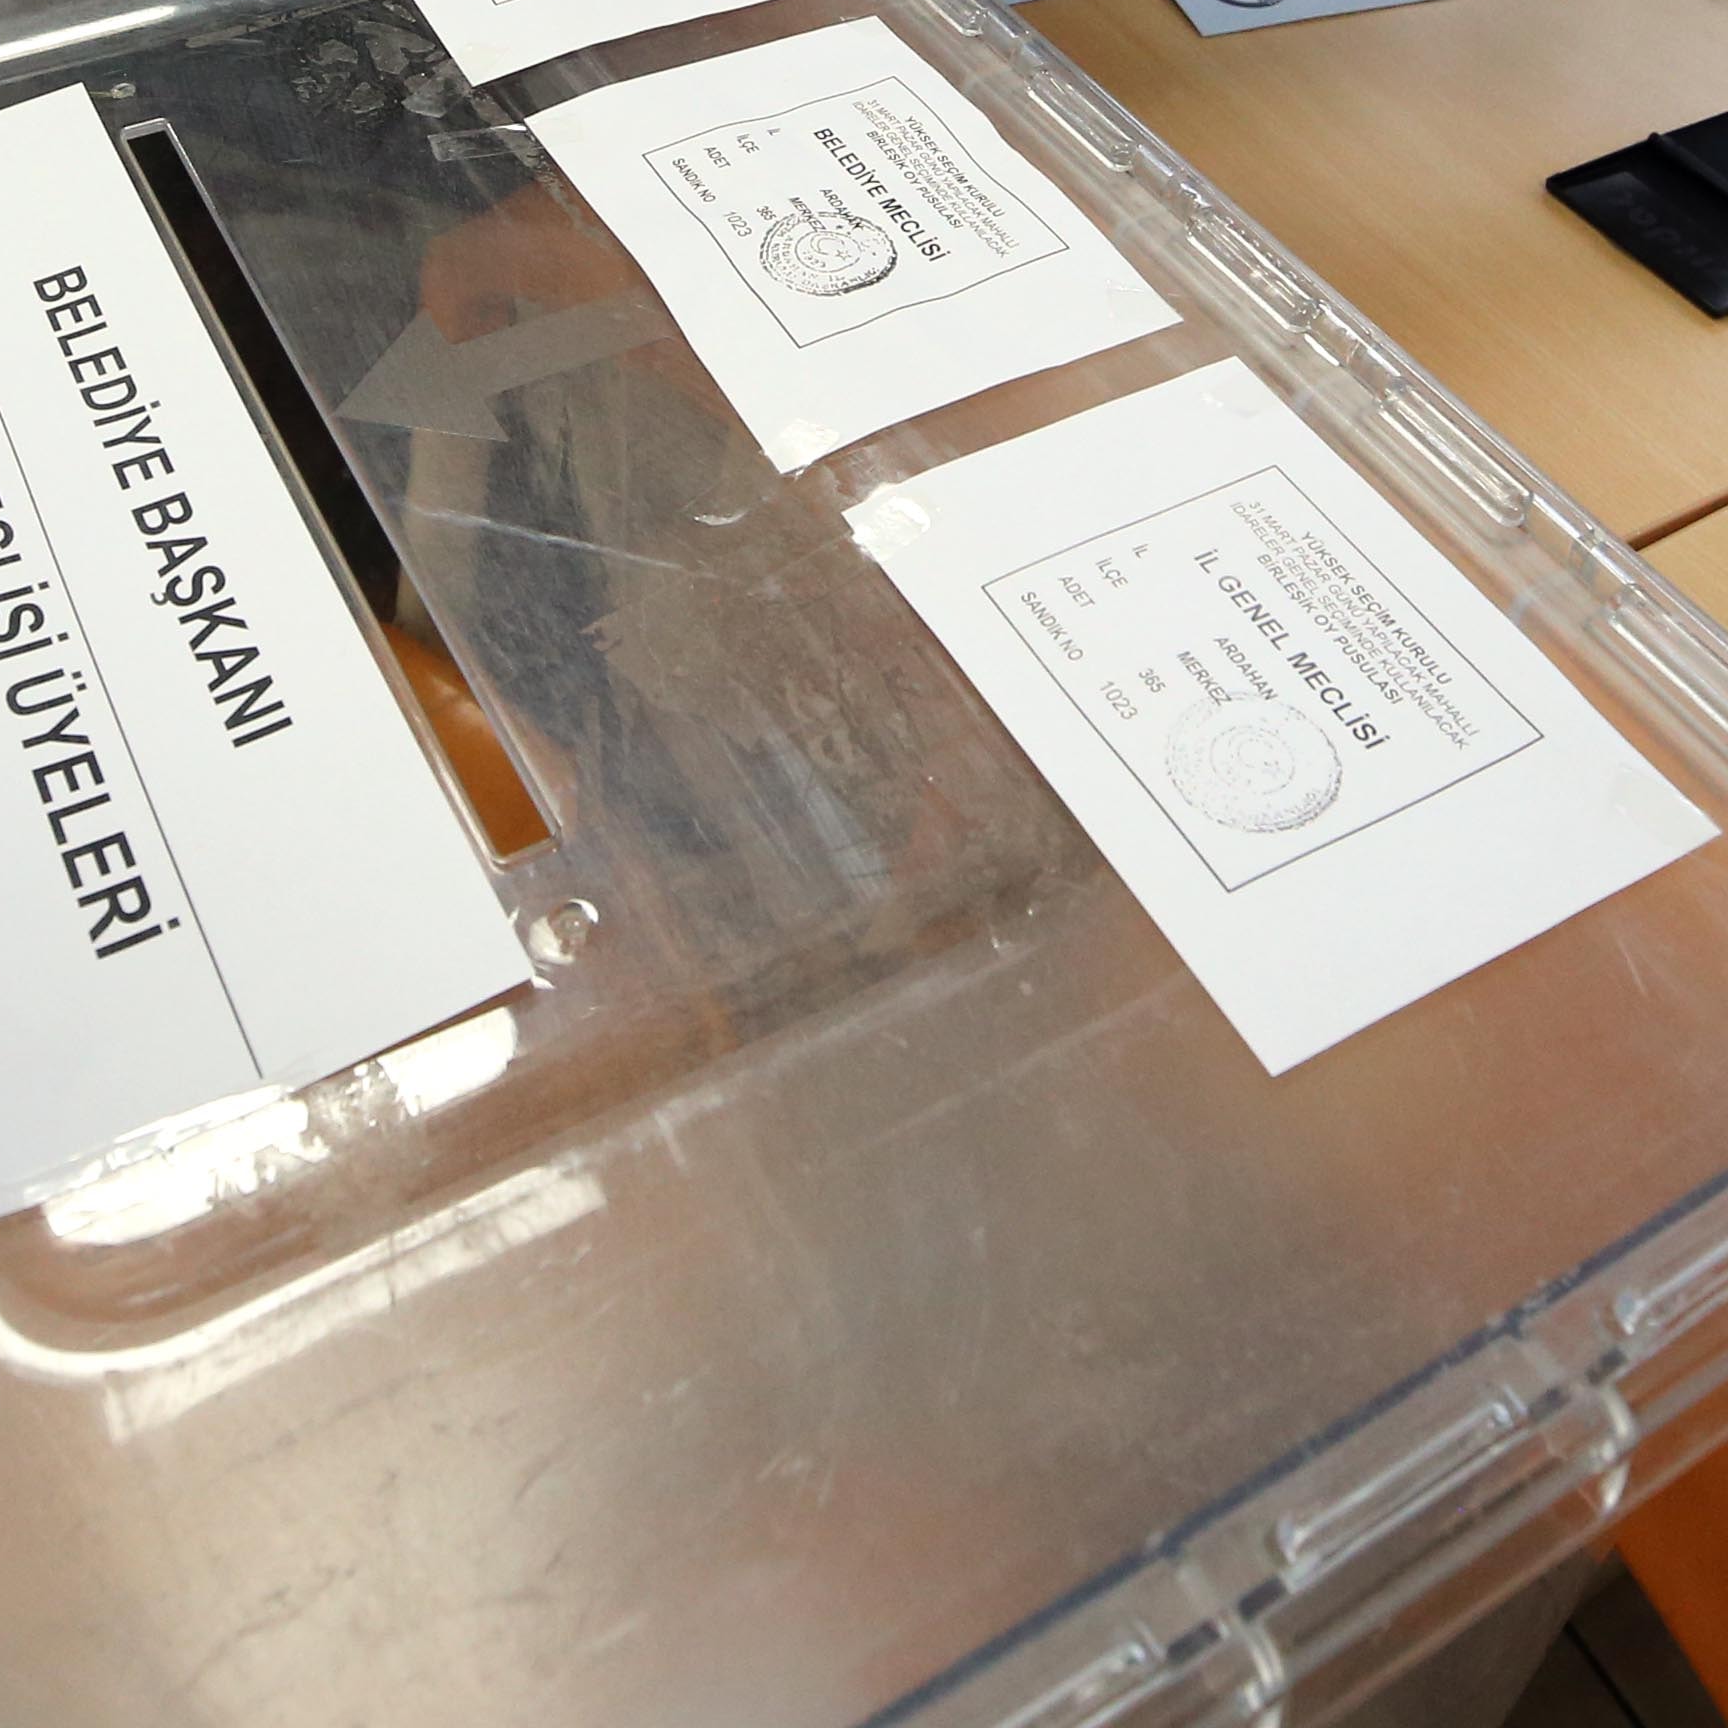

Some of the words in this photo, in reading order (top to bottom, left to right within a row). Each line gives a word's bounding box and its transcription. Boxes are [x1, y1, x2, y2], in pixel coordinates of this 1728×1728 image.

[703, 147, 731, 169] ADET
[756, 205, 777, 221] 365
[723, 211, 753, 238] 1023
[813, 128, 889, 198] BELEDİYE
[878, 198, 951, 262] MECLİSİ
[903, 171, 922, 185] OY
[915, 186, 964, 229] PUSULASI
[905, 116, 942, 155] YÜKSEK
[936, 155, 969, 185] SEÇİM
[963, 184, 1006, 218] KURULU
[32, 265, 175, 491] BELEDİYE
[131, 492, 293, 749] BAŞKANI
[1020, 591, 1068, 641] SANDIK
[1058, 639, 1084, 661] NO
[1099, 681, 1139, 721] 1023
[1057, 576, 1096, 608] ADET
[1138, 668, 1167, 694] 365
[1095, 557, 1129, 589] İLÇE
[1174, 649, 1235, 709] MERKEZ
[1132, 543, 1149, 559] İL
[1213, 638, 1278, 701] ARDAHAN
[1193, 548, 1219, 575] İL
[1218, 575, 1290, 652] GENEL
[1286, 652, 1391, 750] MECLİSİ
[1248, 501, 1266, 514] 31
[1261, 514, 1298, 546] MART
[1291, 546, 1332, 584] PAZAR
[1327, 584, 1367, 618] GÜNÜ
[1361, 617, 1427, 684] YAPILACAK
[1422, 682, 1480, 737] MAHALLİ
[1256, 554, 1319, 614] BİRLEŞİK
[1313, 614, 1339, 633] OY
[1333, 635, 1404, 705] PUSULASI
[1281, 556, 1319, 596] GENEL
[1377, 658, 1470, 751] KULLANILACAK
[1301, 531, 1356, 586] YÜKSEK
[1350, 585, 1397, 628] SEÇİM
[1391, 627, 1453, 685] KURULU
[5, 668, 180, 960] ÜYELERİ
